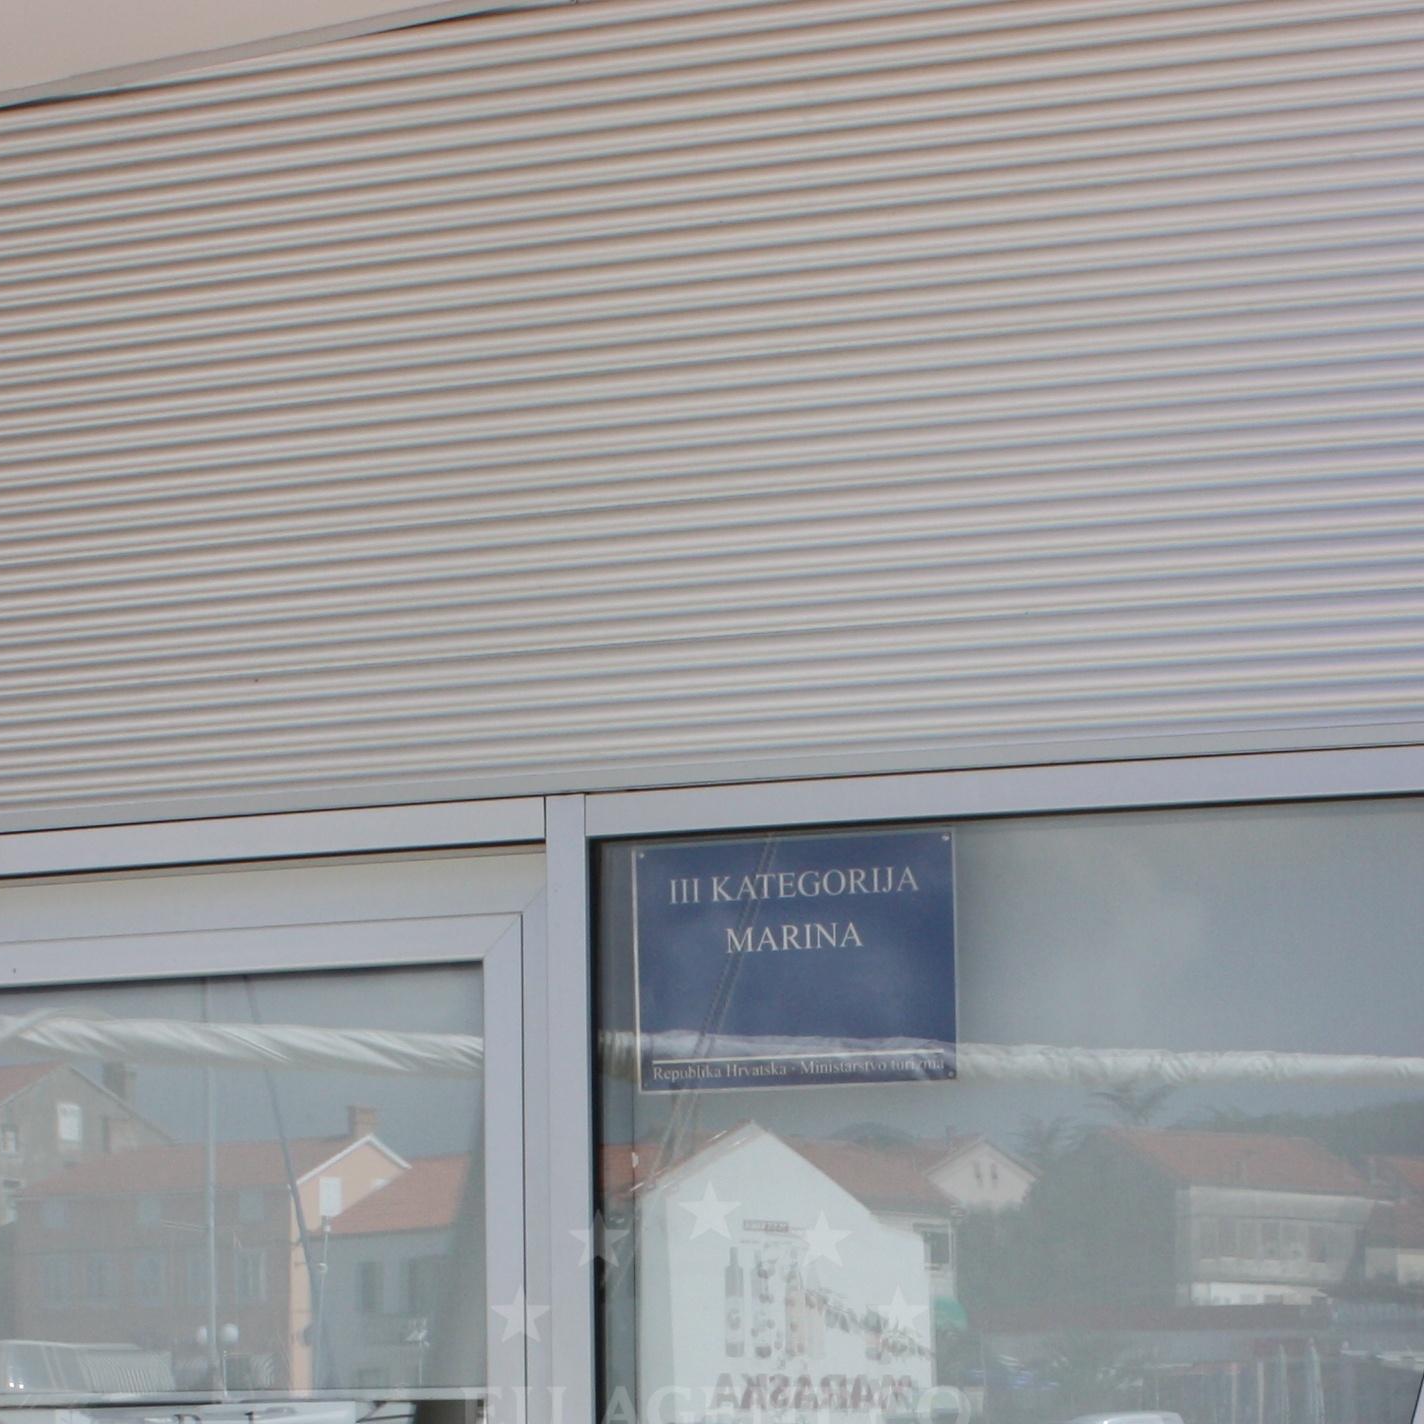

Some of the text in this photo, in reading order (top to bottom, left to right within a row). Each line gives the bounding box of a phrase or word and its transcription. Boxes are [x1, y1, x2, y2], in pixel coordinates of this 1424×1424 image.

[669, 866, 919, 904] III KATEGORIJA
[725, 922, 864, 954] MARINA
[653, 1057, 944, 1082] Republika Hrvatska Ministarstvo turizma
